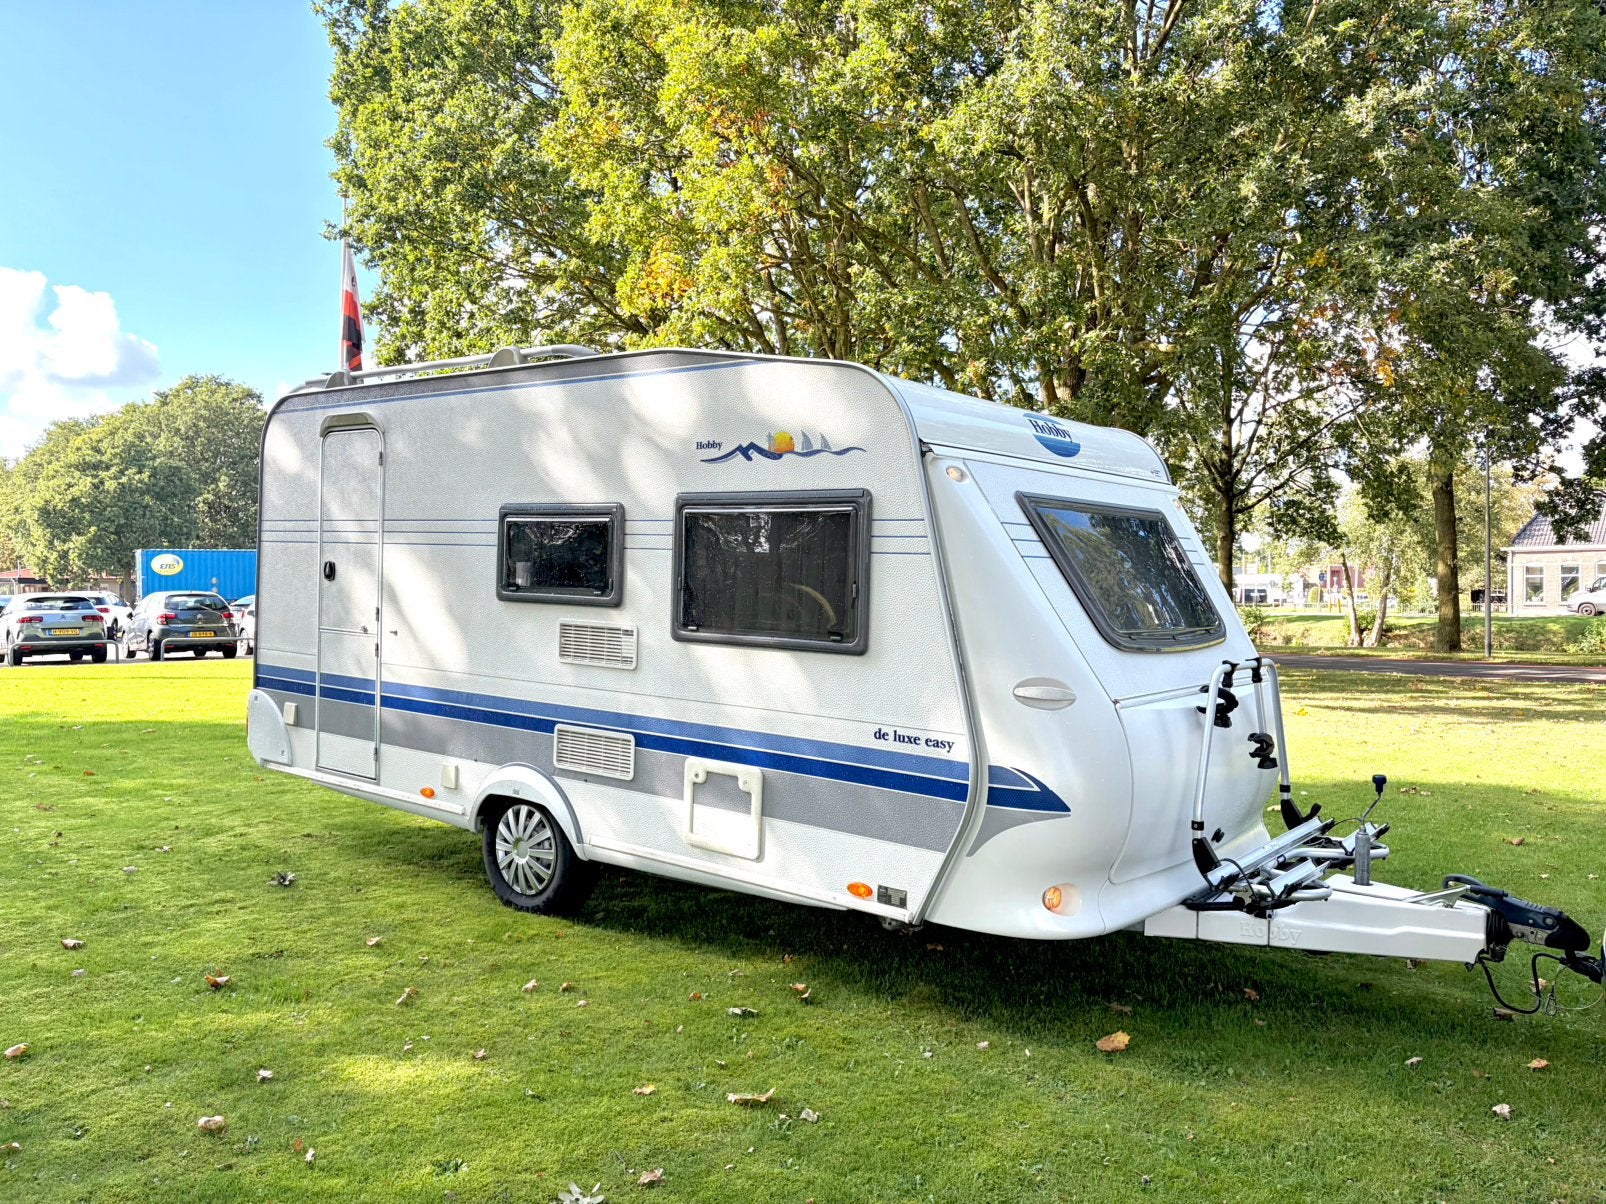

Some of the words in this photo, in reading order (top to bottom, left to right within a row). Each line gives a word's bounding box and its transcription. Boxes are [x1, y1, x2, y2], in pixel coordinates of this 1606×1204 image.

[1027, 418, 1073, 444] Hobby
[695, 440, 723, 451] Hobby
[873, 727, 890, 741] de
[893, 729, 921, 746] luxe
[924, 737, 955, 754] easy
